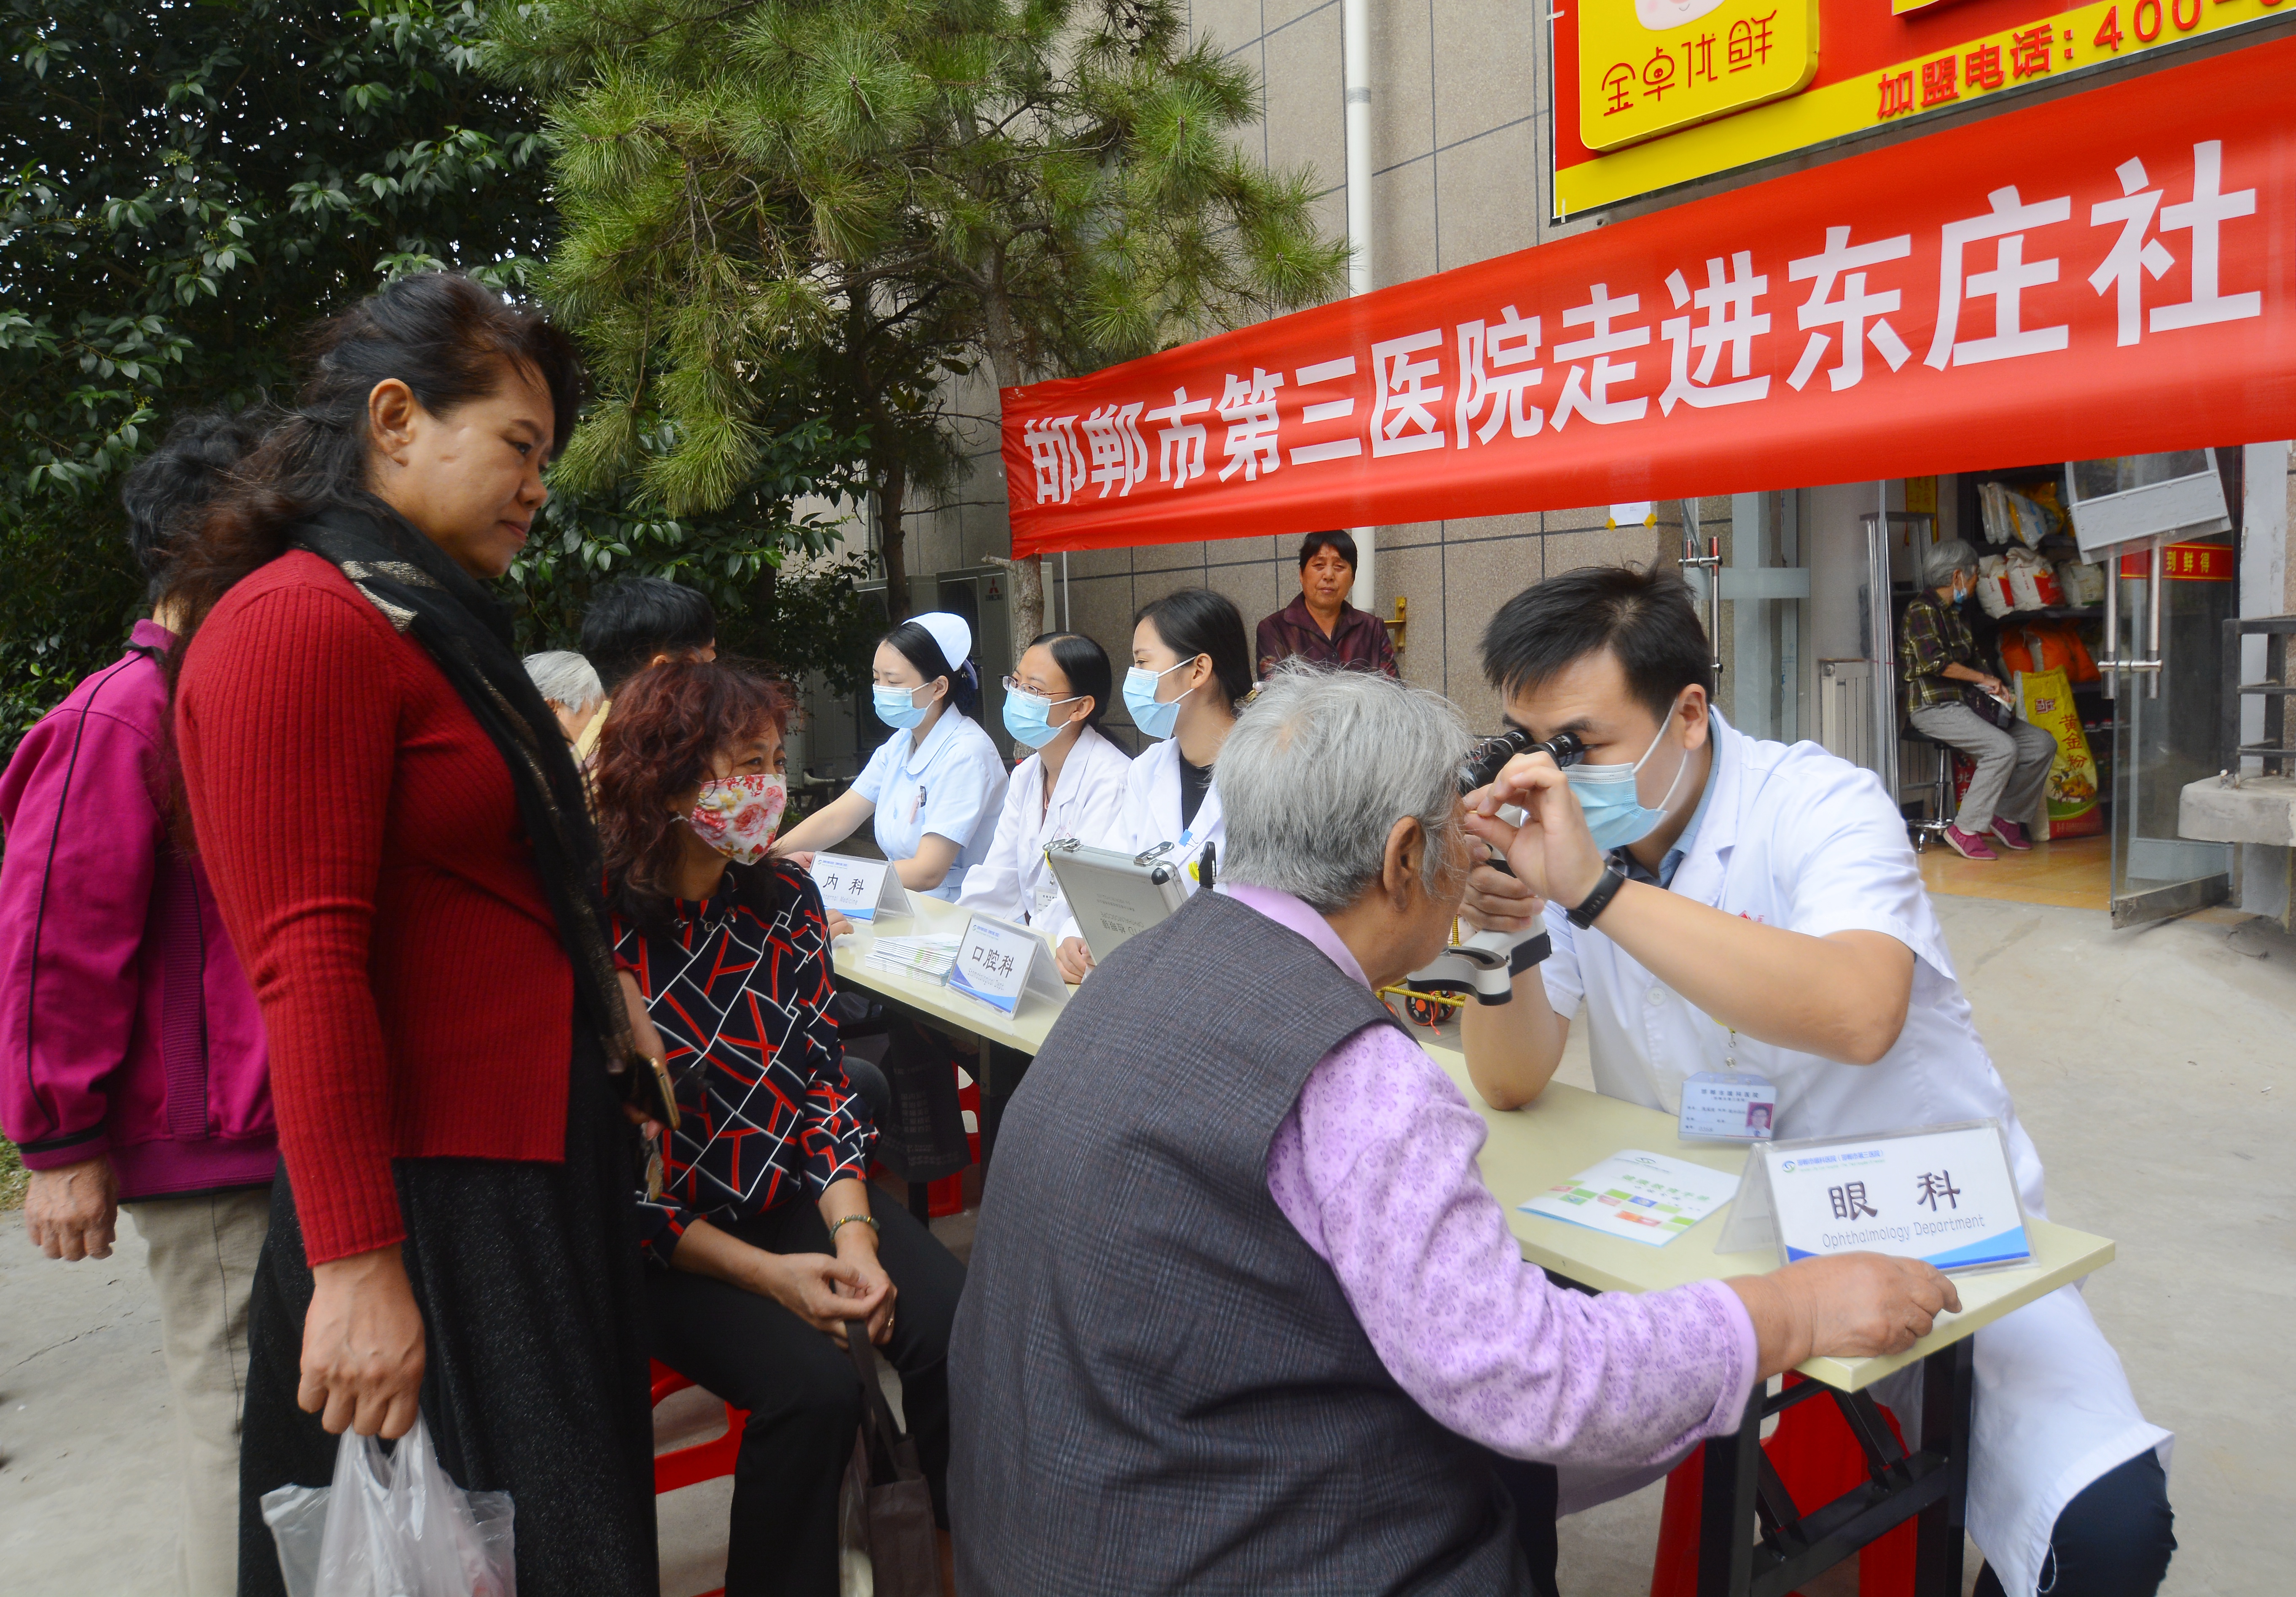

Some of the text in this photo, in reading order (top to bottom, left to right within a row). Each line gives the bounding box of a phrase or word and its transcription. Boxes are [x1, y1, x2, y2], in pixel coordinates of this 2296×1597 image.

[1601, 9, 1777, 117] 金卓优鲜
[1023, 140, 2261, 505] 邯郸市第三医院走进东庄社
[2059, 713, 2088, 770] 黄金粉
[823, 873, 864, 896] 内科
[972, 945, 1014, 978] 口腔科
[1827, 1169, 1961, 1221] 眼科
[1822, 1214, 1985, 1249] Ophthalmology Department
